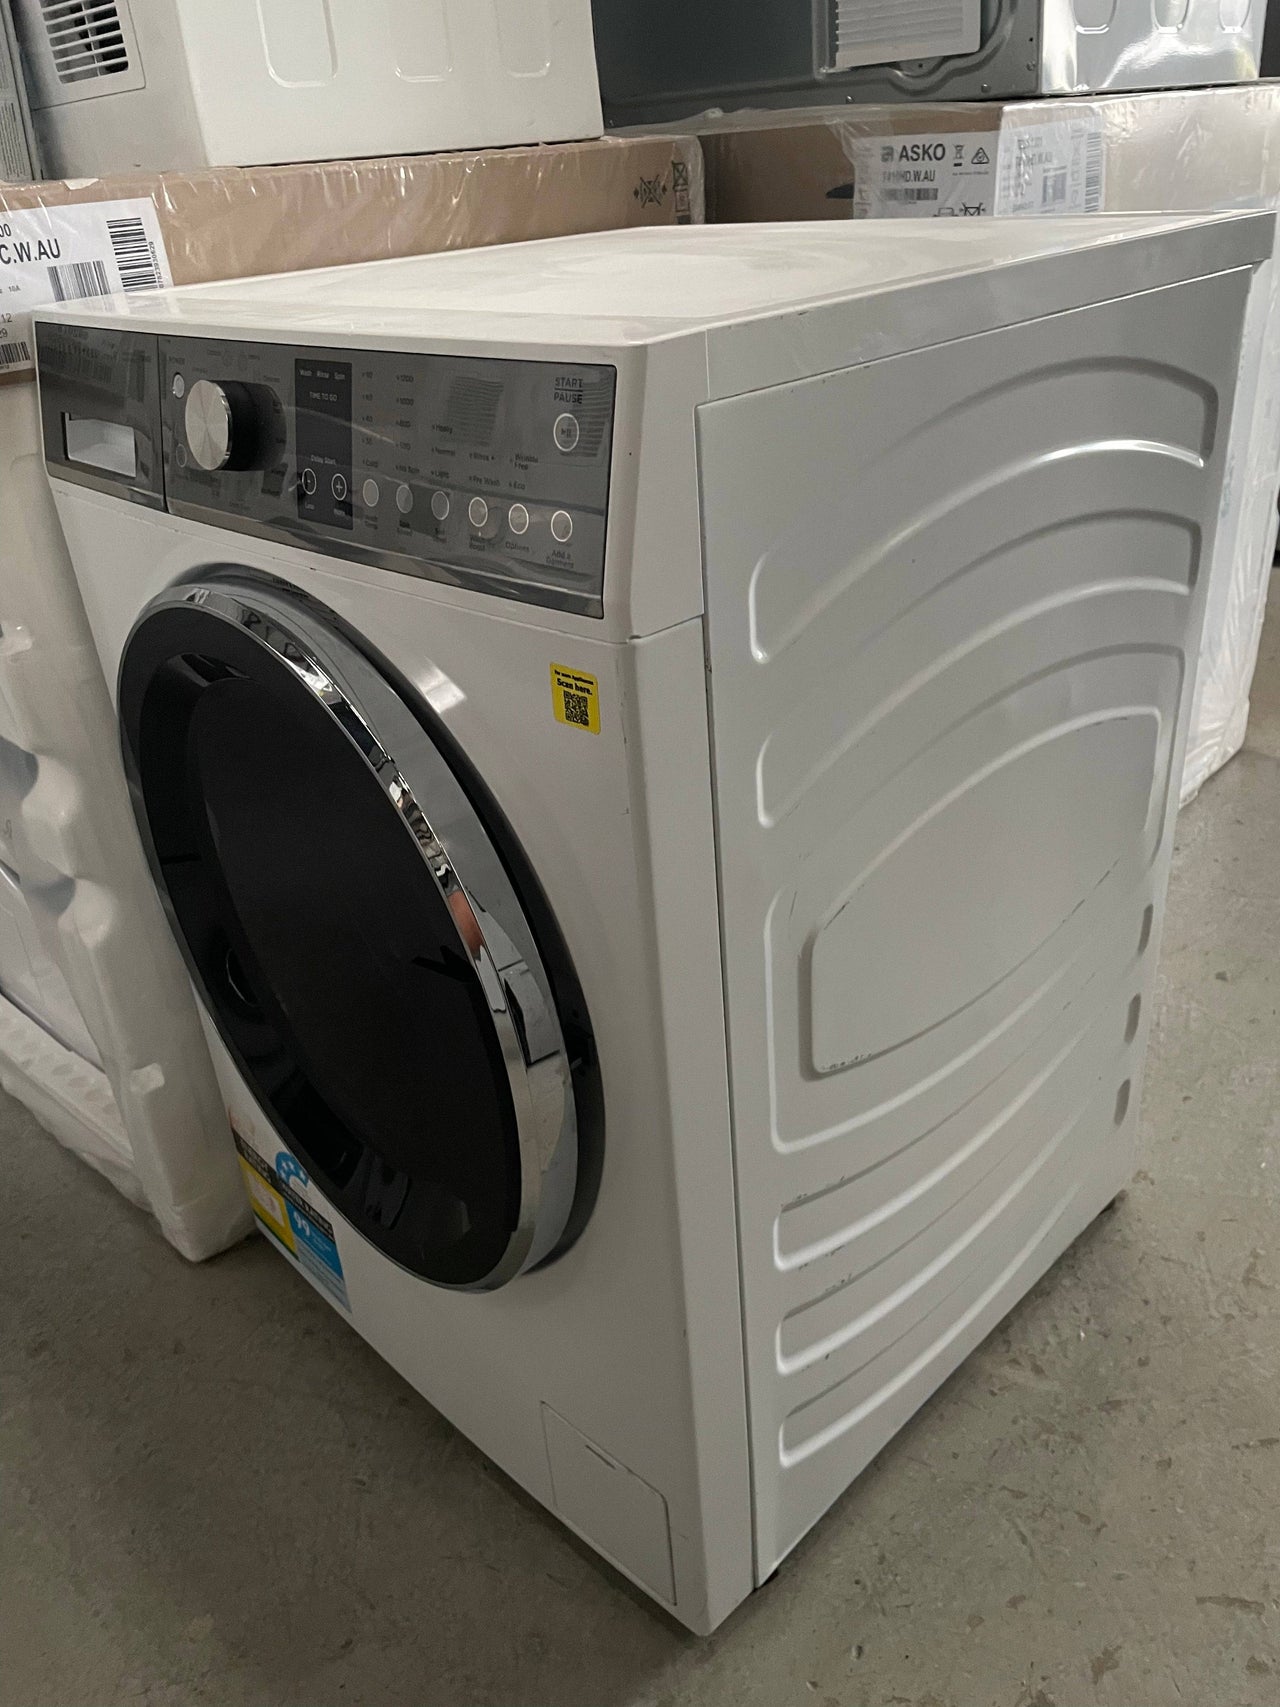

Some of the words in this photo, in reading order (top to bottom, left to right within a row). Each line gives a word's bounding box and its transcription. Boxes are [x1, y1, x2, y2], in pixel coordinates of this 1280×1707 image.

[899, 143, 946, 162] ASKO
[555, 376, 583, 388] START
[554, 391, 583, 404] PAUSE
[556, 678, 573, 690] Scan
